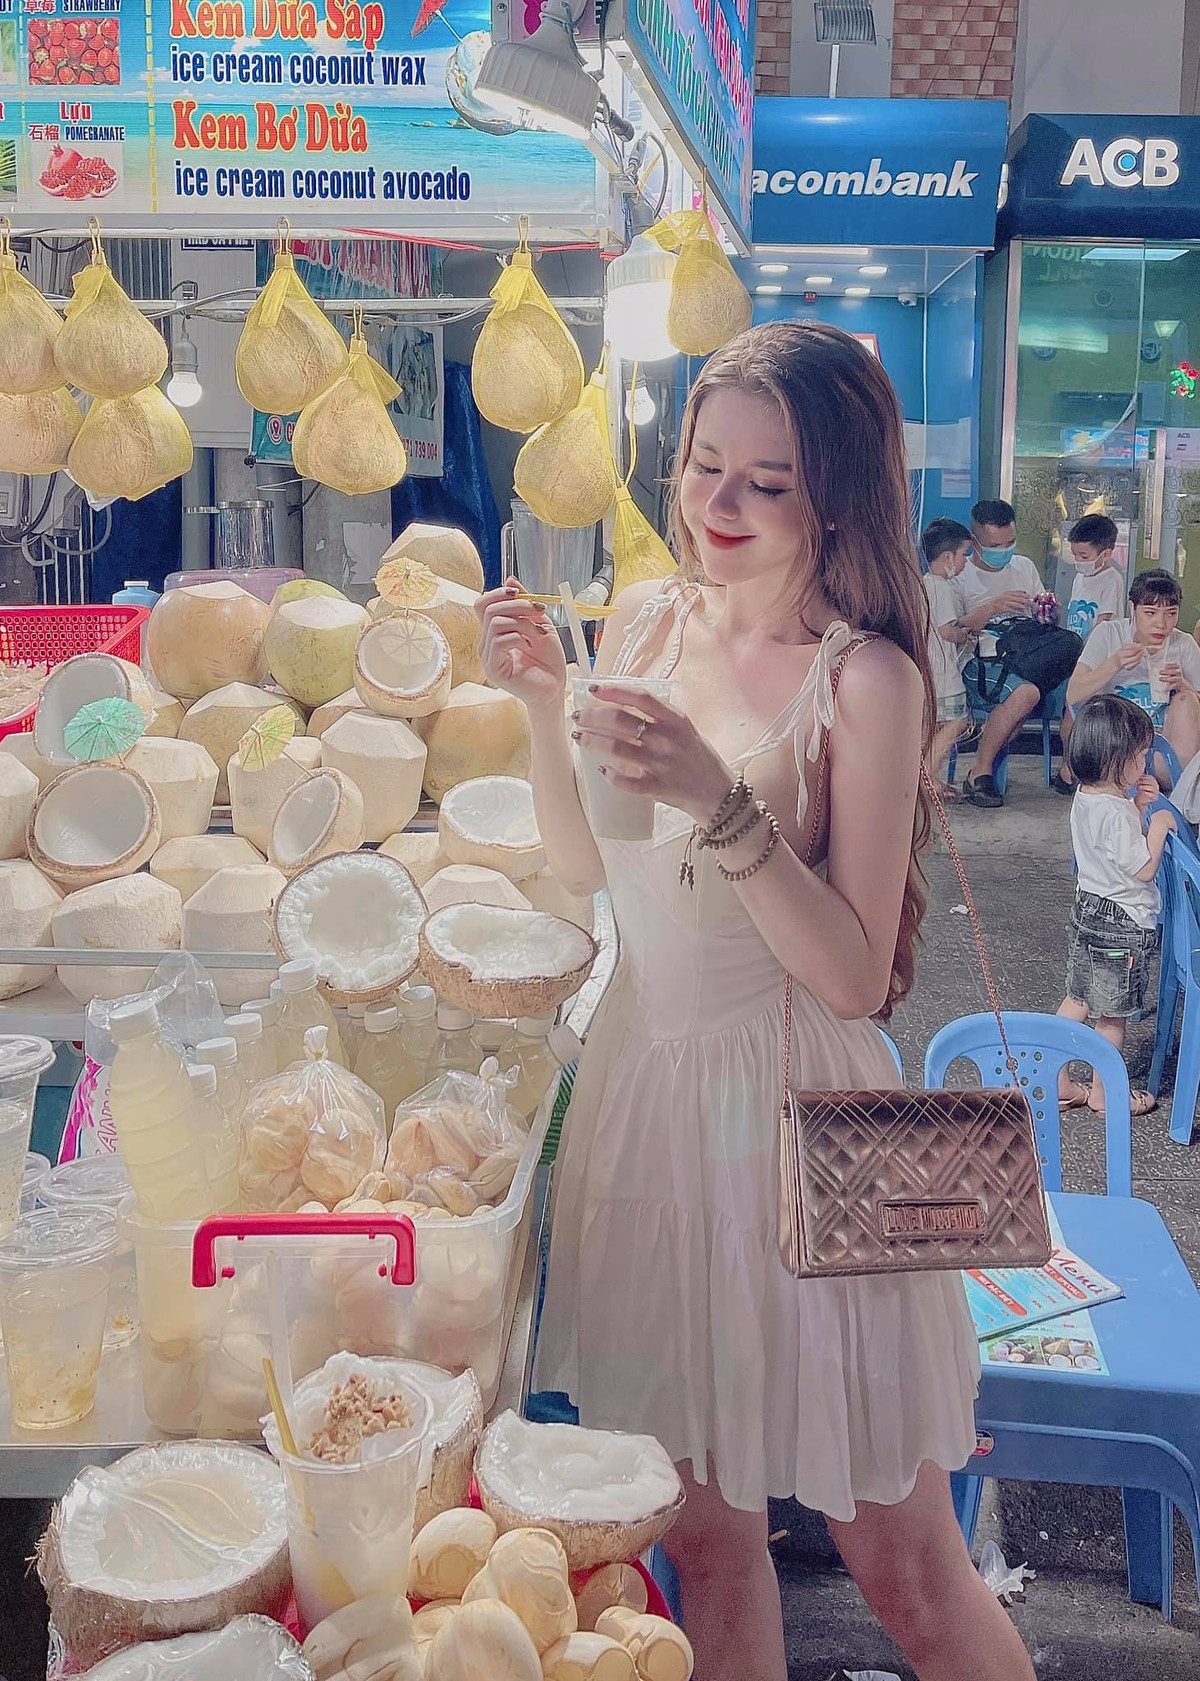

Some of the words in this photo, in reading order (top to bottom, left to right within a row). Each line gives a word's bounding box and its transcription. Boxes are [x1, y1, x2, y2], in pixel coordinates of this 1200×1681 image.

[63, 0, 120, 11] STRAWBERRY
[170, 0, 246, 38] Kem
[172, 46, 205, 82] ice
[213, 53, 283, 84] cream
[290, 52, 375, 85] coconut
[382, 55, 427, 86] wax
[29, 125, 59, 141] 石榴
[65, 126, 125, 141] POMEGRANATE
[171, 101, 248, 150] Kem
[255, 102, 298, 151] Bơ
[305, 102, 369, 152] Dừa
[175, 161, 208, 196] ice
[215, 167, 286, 198] cream
[293, 166, 376, 199] coconut
[382, 166, 471, 201] avocado
[753, 158, 979, 197] acombank
[1060, 138, 1180, 187] ACB
